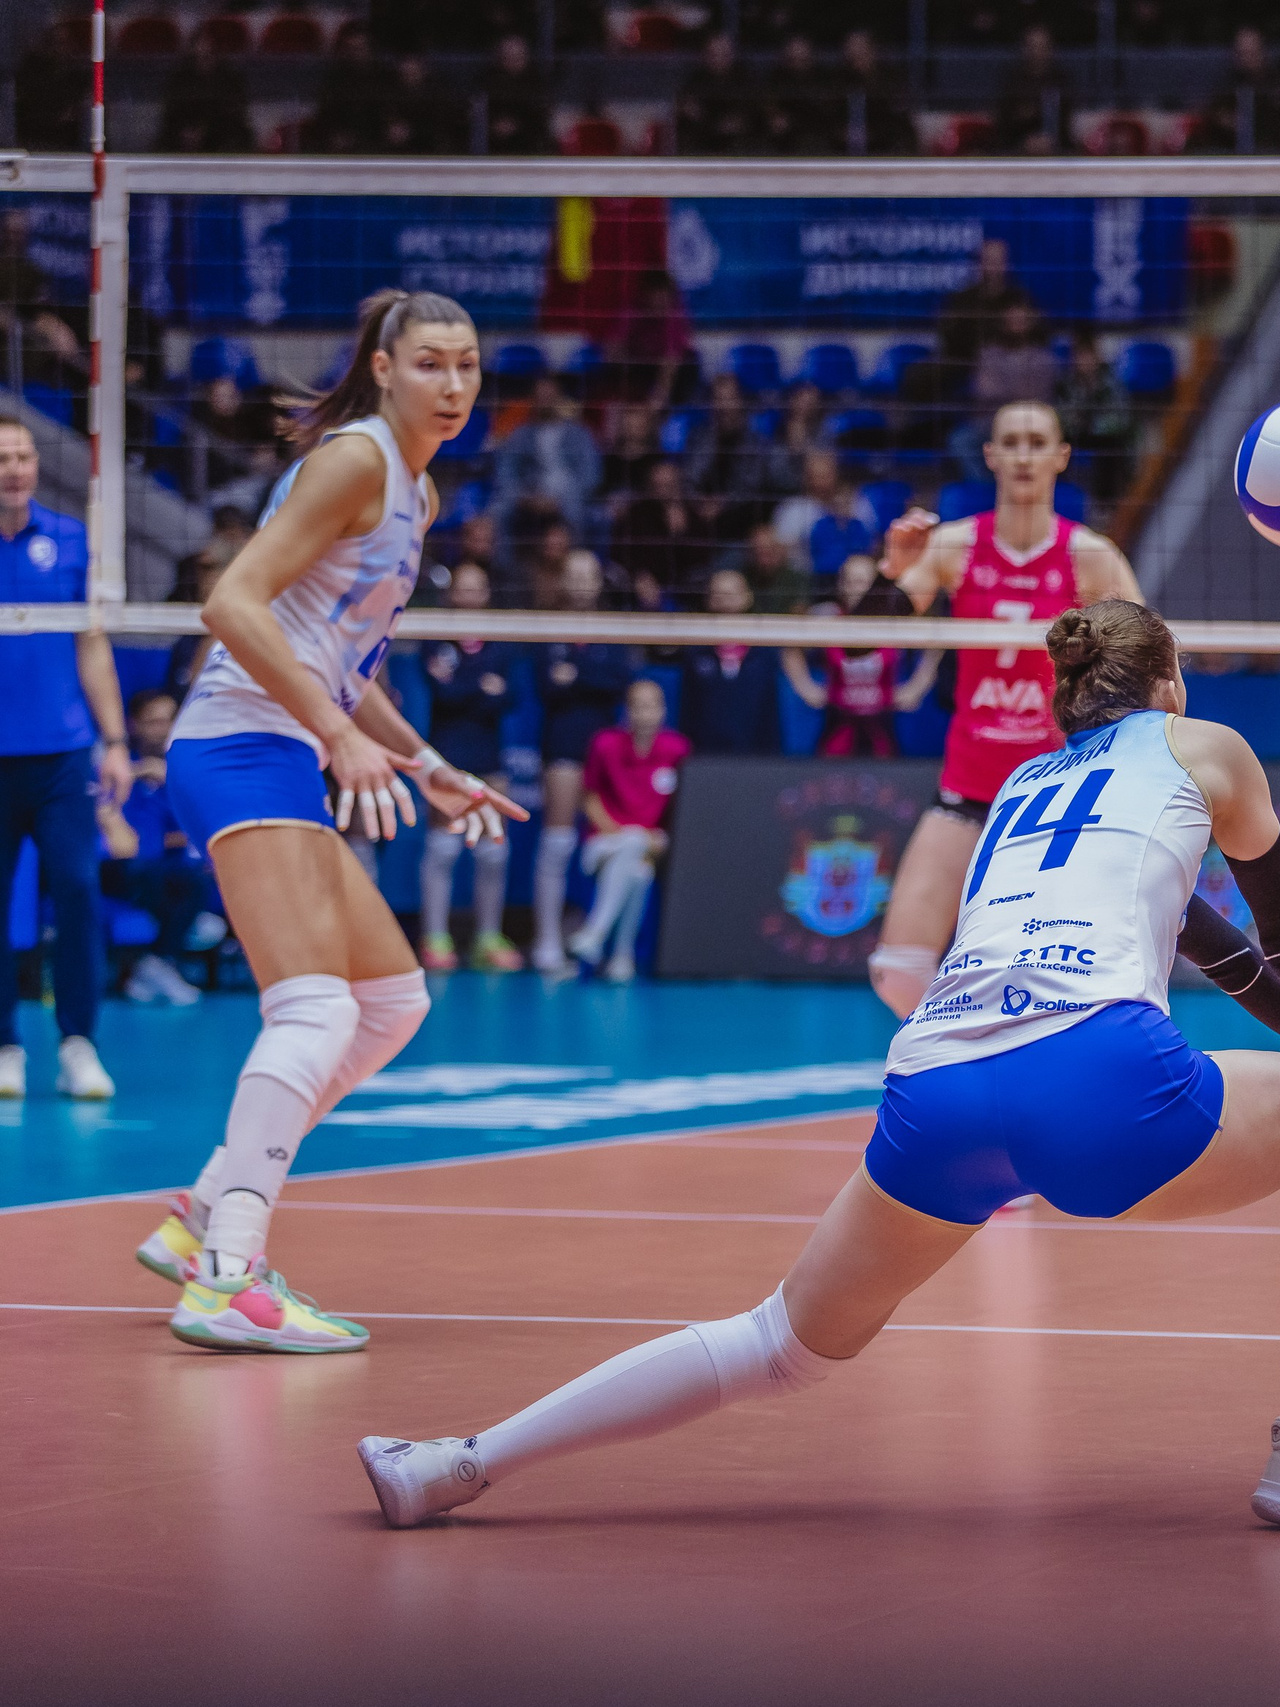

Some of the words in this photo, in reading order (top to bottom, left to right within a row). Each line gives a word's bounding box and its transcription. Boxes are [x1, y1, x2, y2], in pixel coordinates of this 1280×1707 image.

[1012, 726, 1119, 788] ГАТИНА
[966, 768, 1115, 906] 14
[988, 891, 1035, 906] ENSEN
[1039, 944, 1096, 965] ТТС
[1033, 999, 1095, 1012] soller
